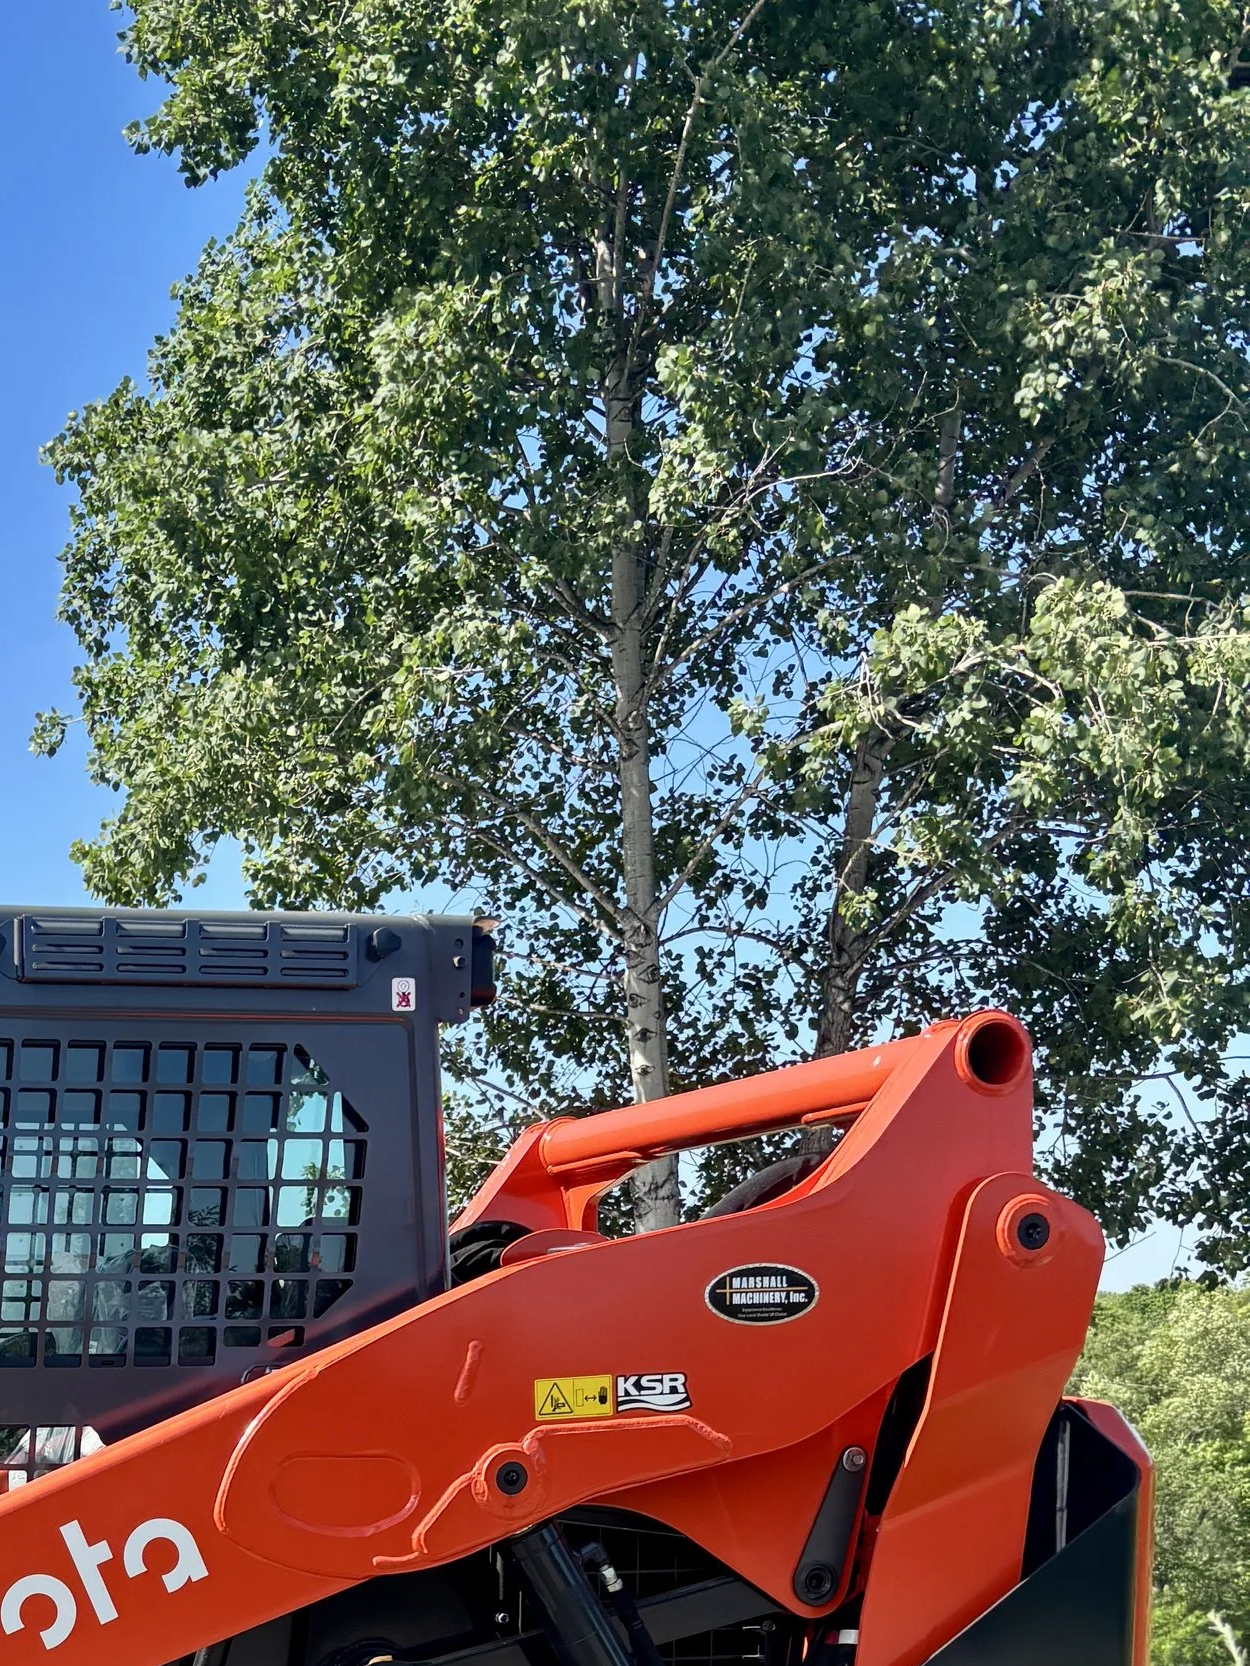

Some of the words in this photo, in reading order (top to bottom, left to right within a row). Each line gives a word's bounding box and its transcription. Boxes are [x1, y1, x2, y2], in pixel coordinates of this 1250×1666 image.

[732, 1275, 788, 1289] MARSHALL
[732, 1291, 788, 1305] MACHINERY,
[789, 1290, 808, 1303] Inc.
[617, 1373, 686, 1397] KSR
